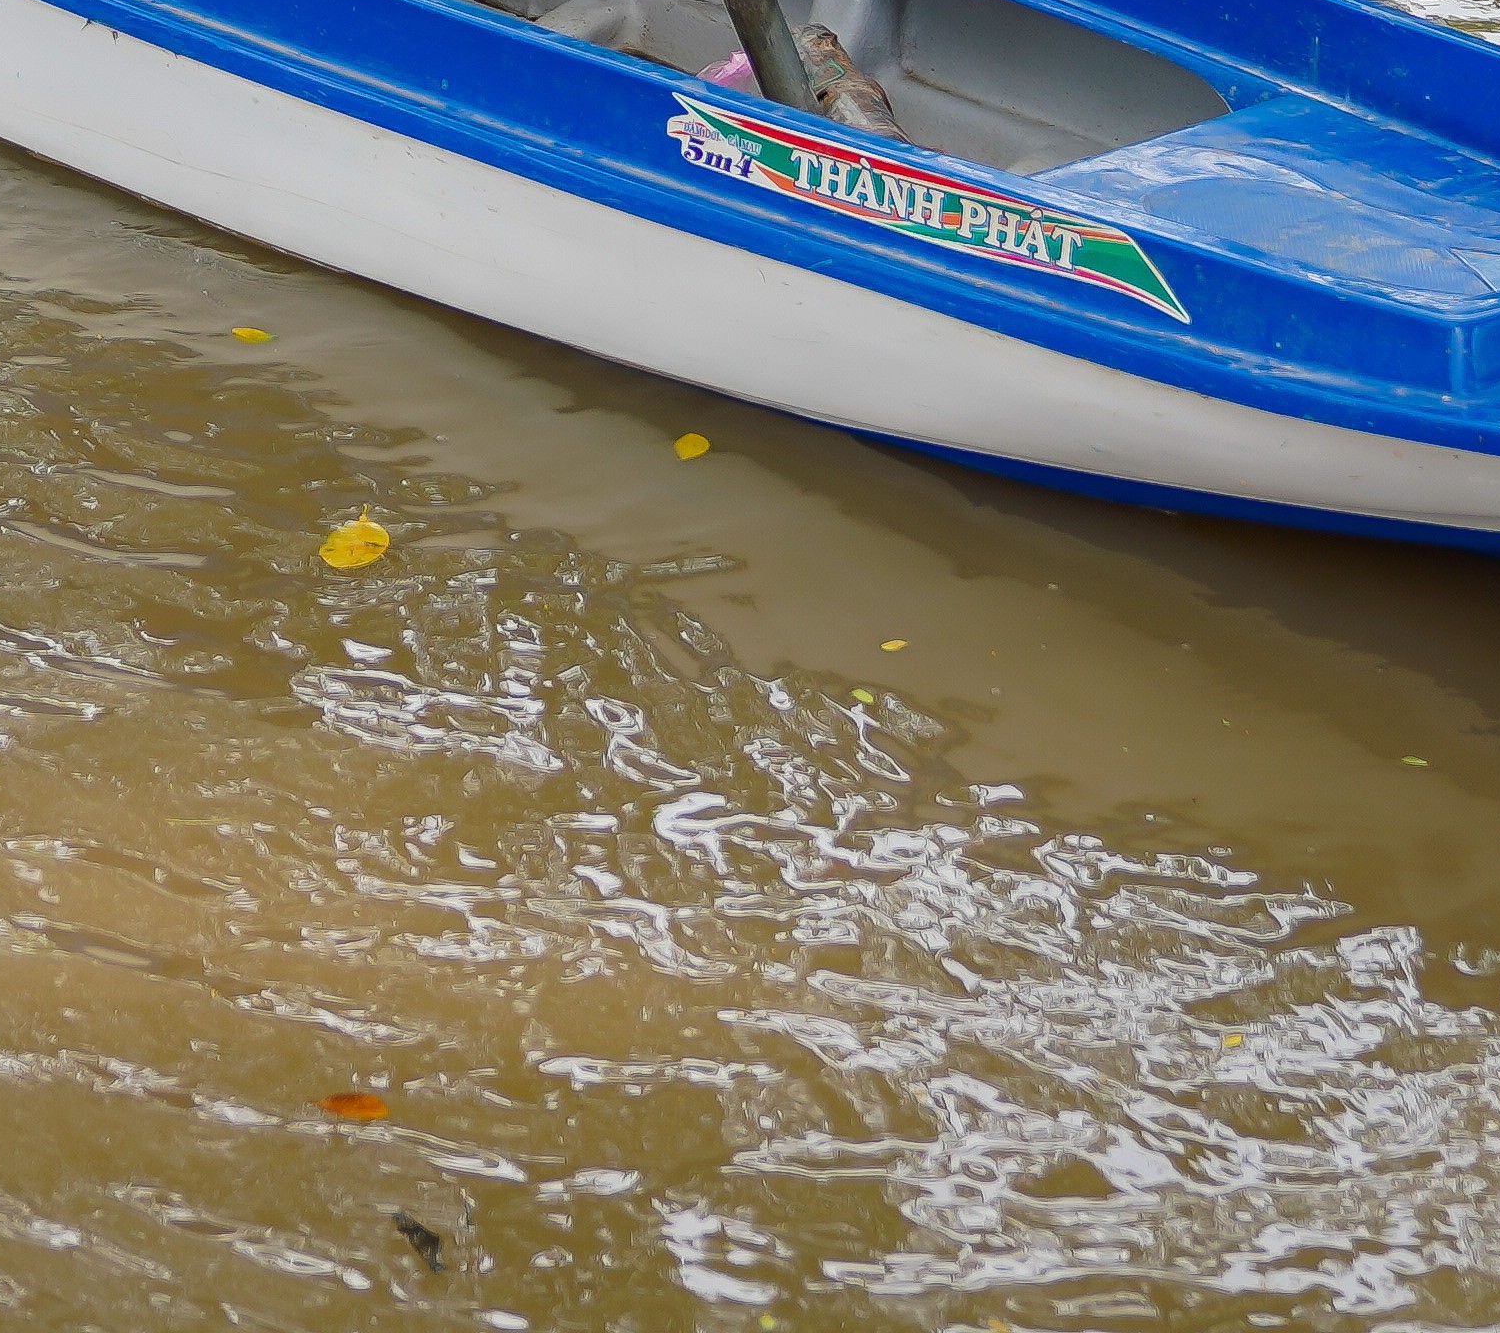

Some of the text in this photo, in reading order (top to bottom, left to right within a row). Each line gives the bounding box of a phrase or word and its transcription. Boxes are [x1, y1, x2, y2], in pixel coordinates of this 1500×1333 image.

[683, 135, 754, 179] 5m4
[789, 149, 1083, 271] THÀNH PHÁT
